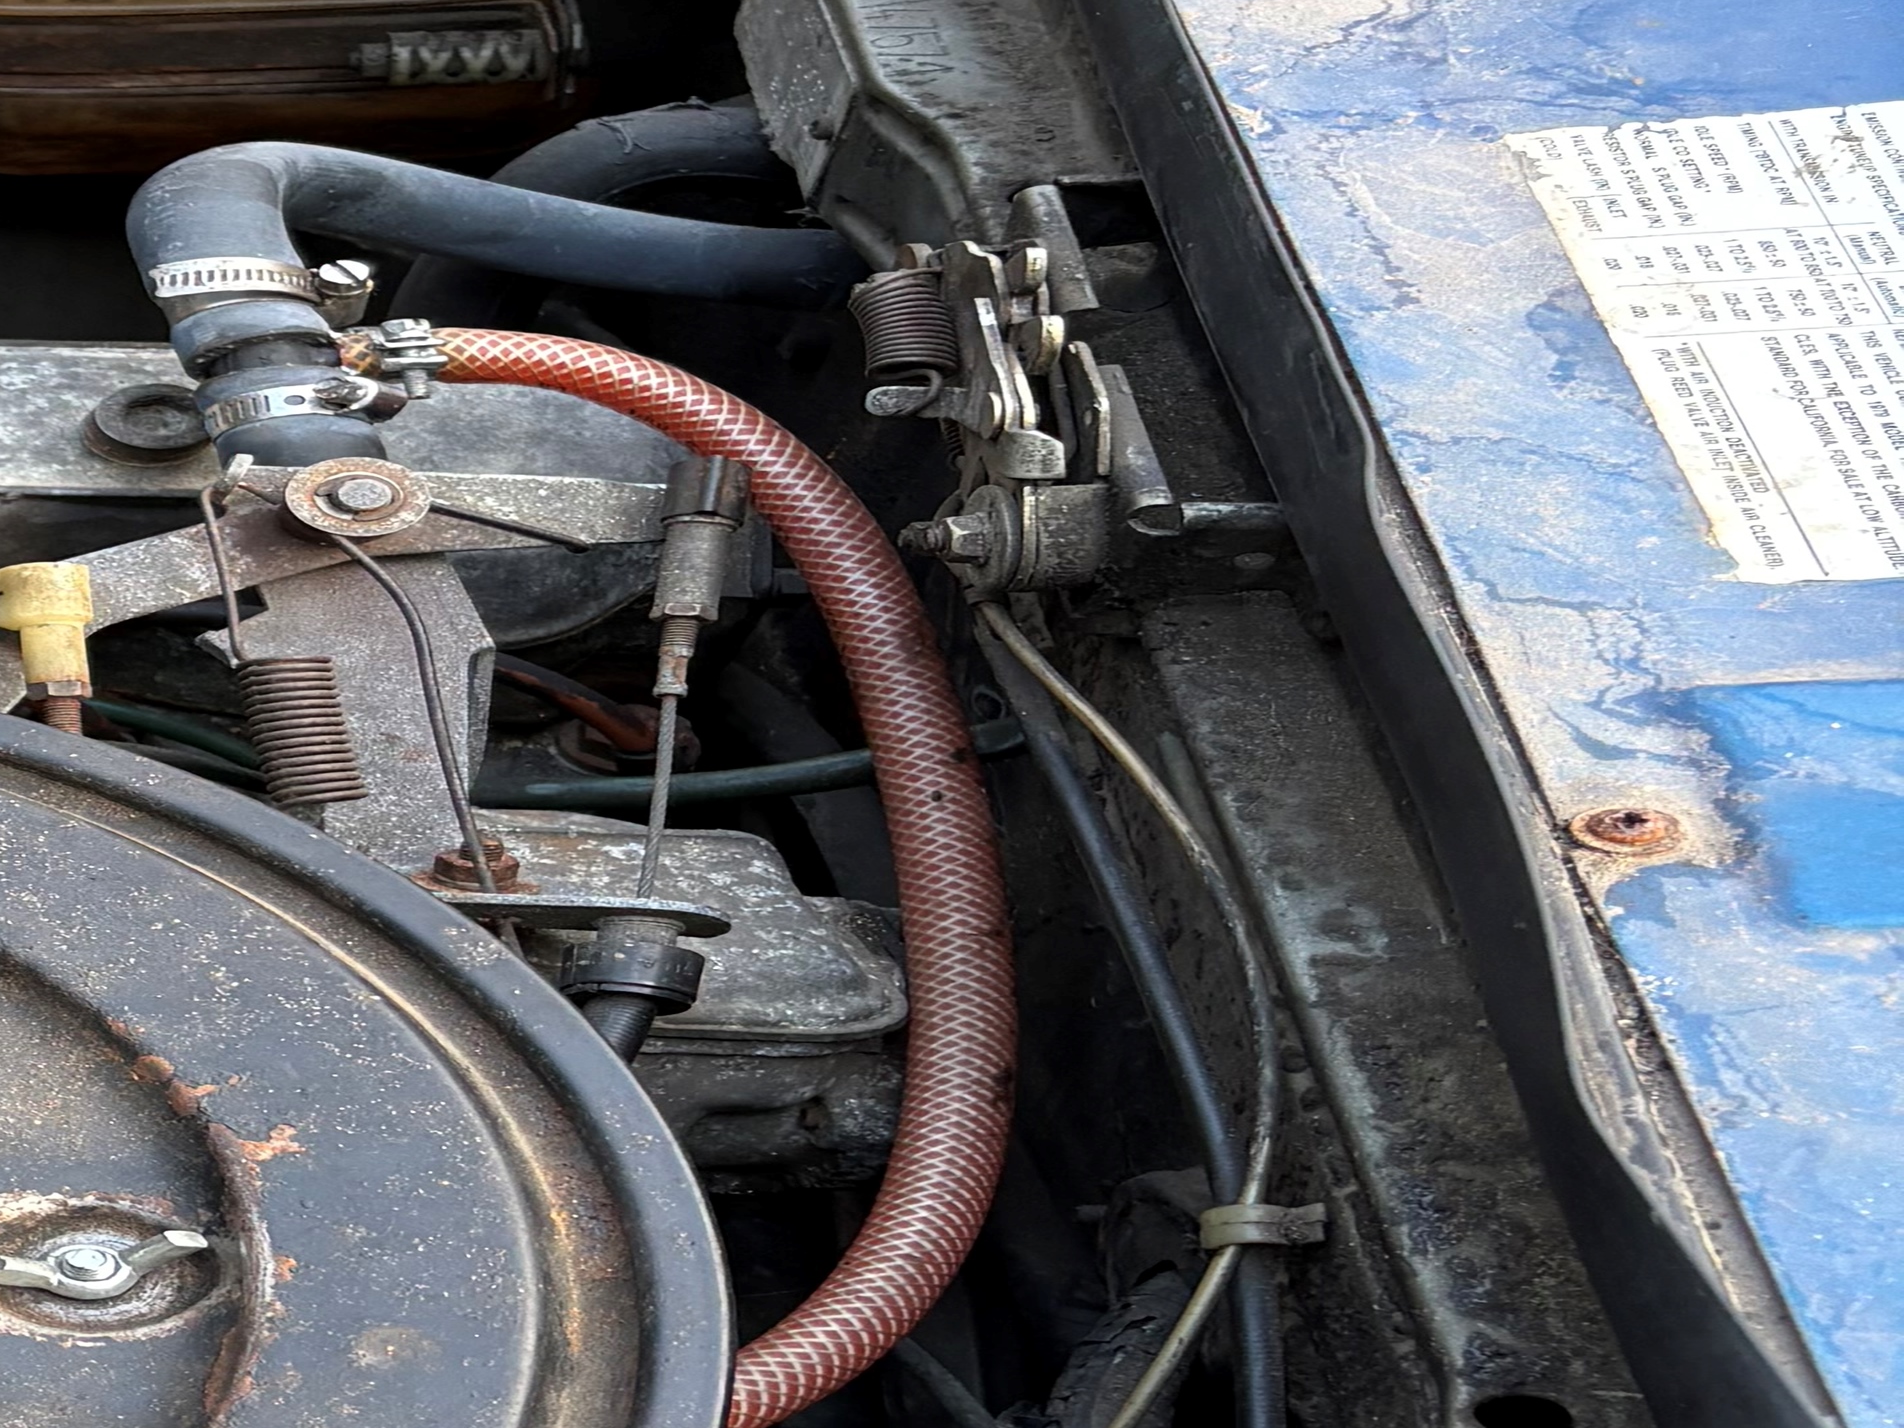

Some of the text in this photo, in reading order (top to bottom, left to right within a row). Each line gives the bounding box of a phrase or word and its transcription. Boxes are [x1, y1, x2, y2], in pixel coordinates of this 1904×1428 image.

[1738, 122, 1763, 148] TIMING
[1673, 145, 1690, 157] CO
[1868, 231, 1899, 266] NEUTRAL
[1761, 336, 1799, 378] STANDARD
[1828, 333, 1868, 380] APPLICABLE
[1859, 383, 1877, 396] TO
[1861, 330, 1904, 385] THIS VEHICLE
[1787, 379, 1809, 397] FOR
[1690, 371, 1709, 385] AIR
[1700, 388, 1735, 433] INDUCTION
[1725, 437, 1770, 494] DEACTIVATED
[1809, 358, 1832, 380] WITH
[1833, 400, 1872, 446] EXCEPTION
[1862, 449, 1882, 460] OF
[1872, 463, 1893, 481] THE
[1672, 376, 1693, 398] REED
[1684, 401, 1709, 428] VALVE
[1700, 431, 1719, 445] AIR
[1723, 475, 1751, 504] INSIDE
[1741, 507, 1760, 521] AIR
[1830, 449, 1851, 467] FOR
[1838, 467, 1865, 490] SALE
[1852, 491, 1872, 502] AT
[1859, 504, 1884, 523] LOW
